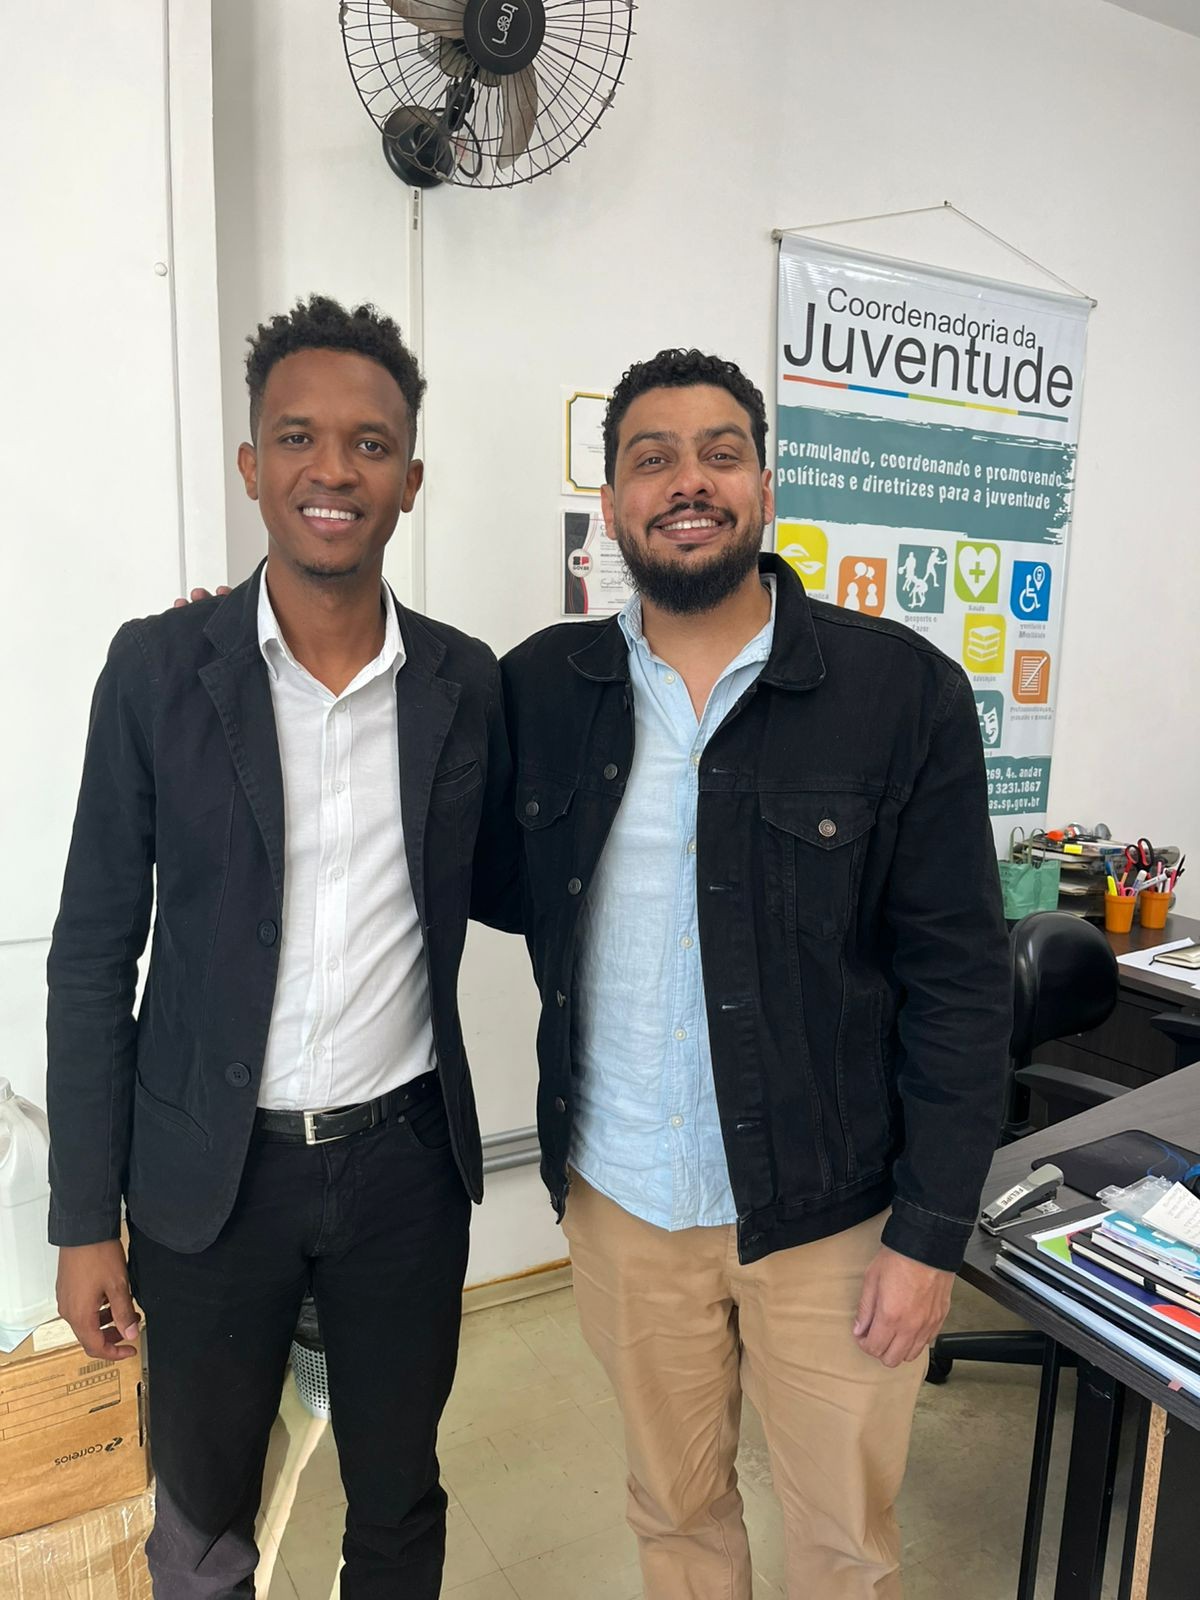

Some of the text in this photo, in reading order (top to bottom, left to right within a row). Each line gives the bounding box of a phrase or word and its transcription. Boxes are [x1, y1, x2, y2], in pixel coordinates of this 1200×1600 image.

[827, 287, 1036, 349] Coordenadoria da
[783, 302, 1073, 408] Juventude
[778, 439, 1062, 488] Formulando, coordenando e promovendo
[777, 465, 1051, 510] políticas e diretrizes para a juventude
[996, 781, 1041, 794] 3231.1867
[1019, 766, 1042, 778] andar
